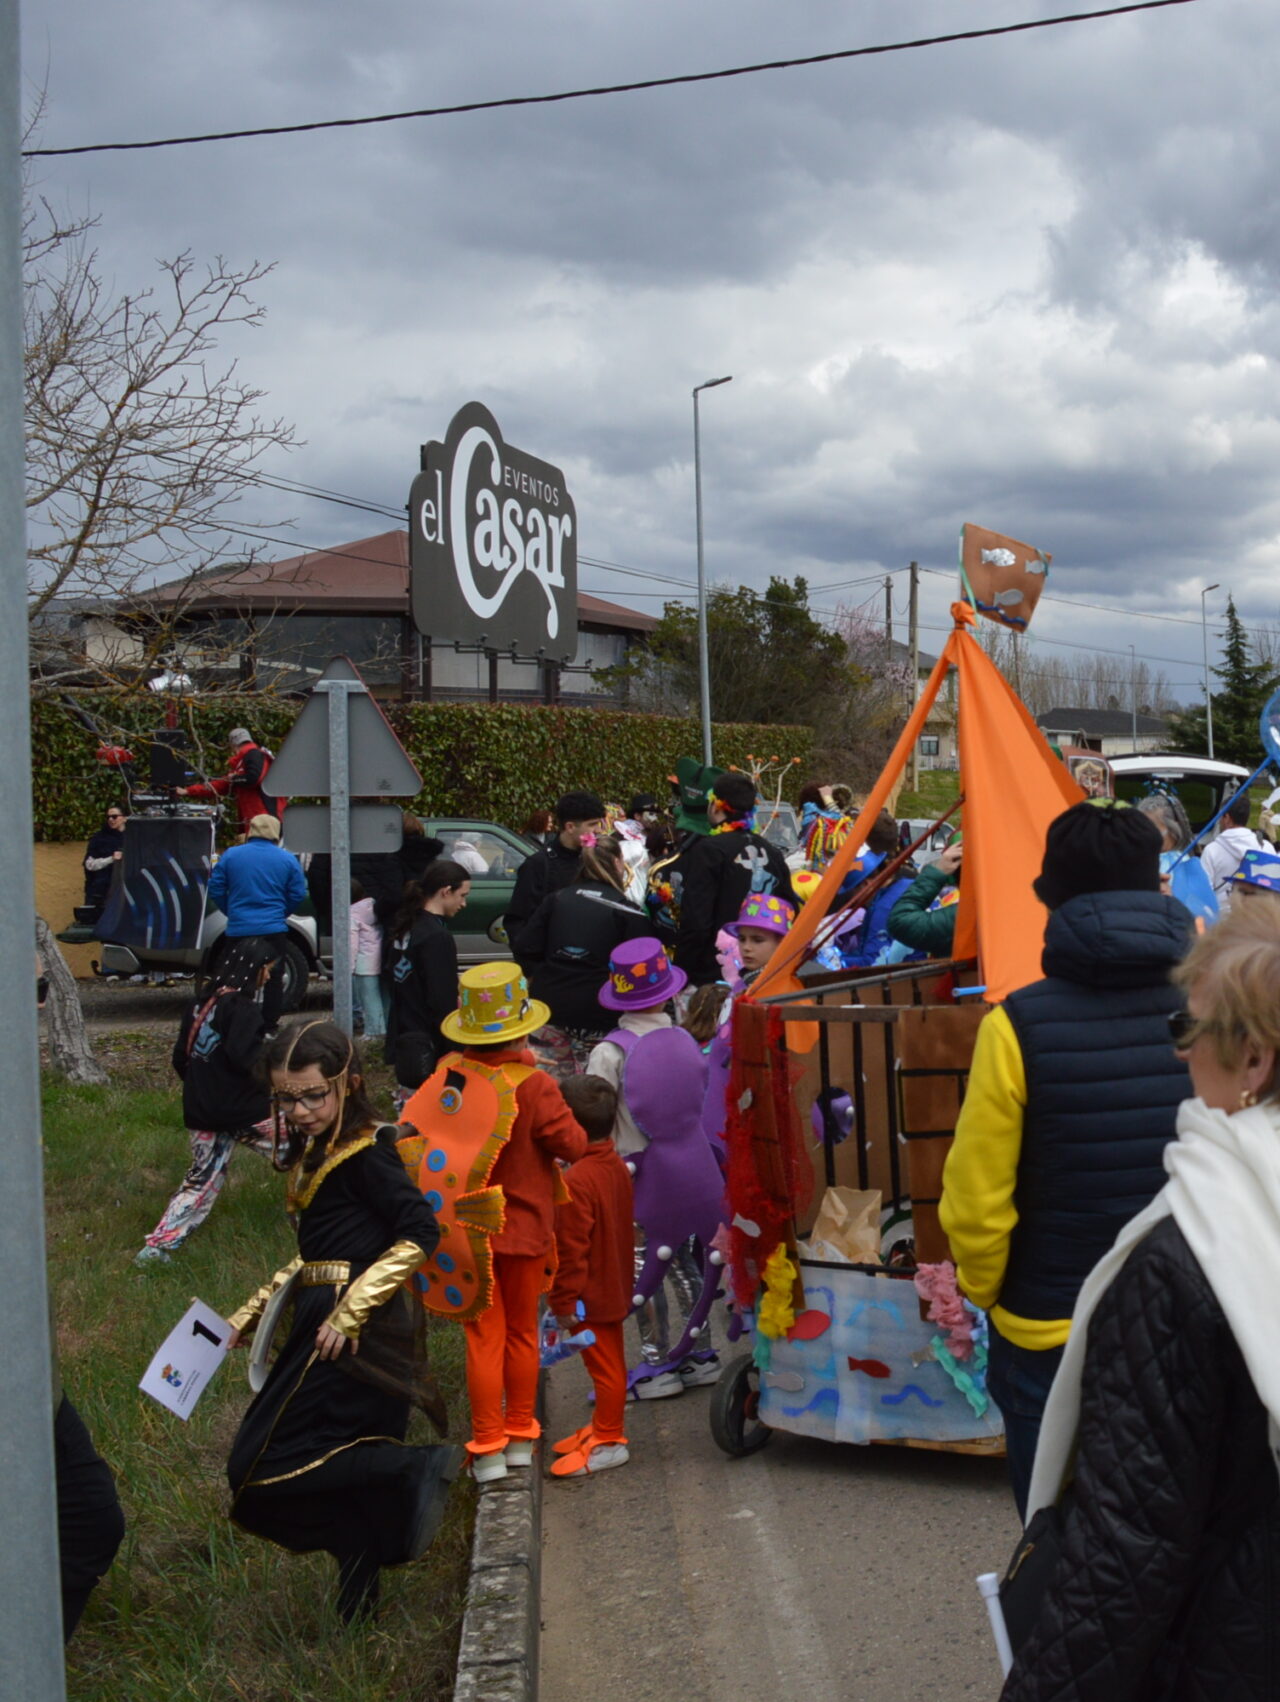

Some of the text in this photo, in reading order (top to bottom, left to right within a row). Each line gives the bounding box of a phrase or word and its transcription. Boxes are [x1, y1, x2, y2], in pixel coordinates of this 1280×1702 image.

[504, 465, 559, 507] EVENTOS
[421, 426, 572, 639] el Casar
[192, 1319, 223, 1347] 1
